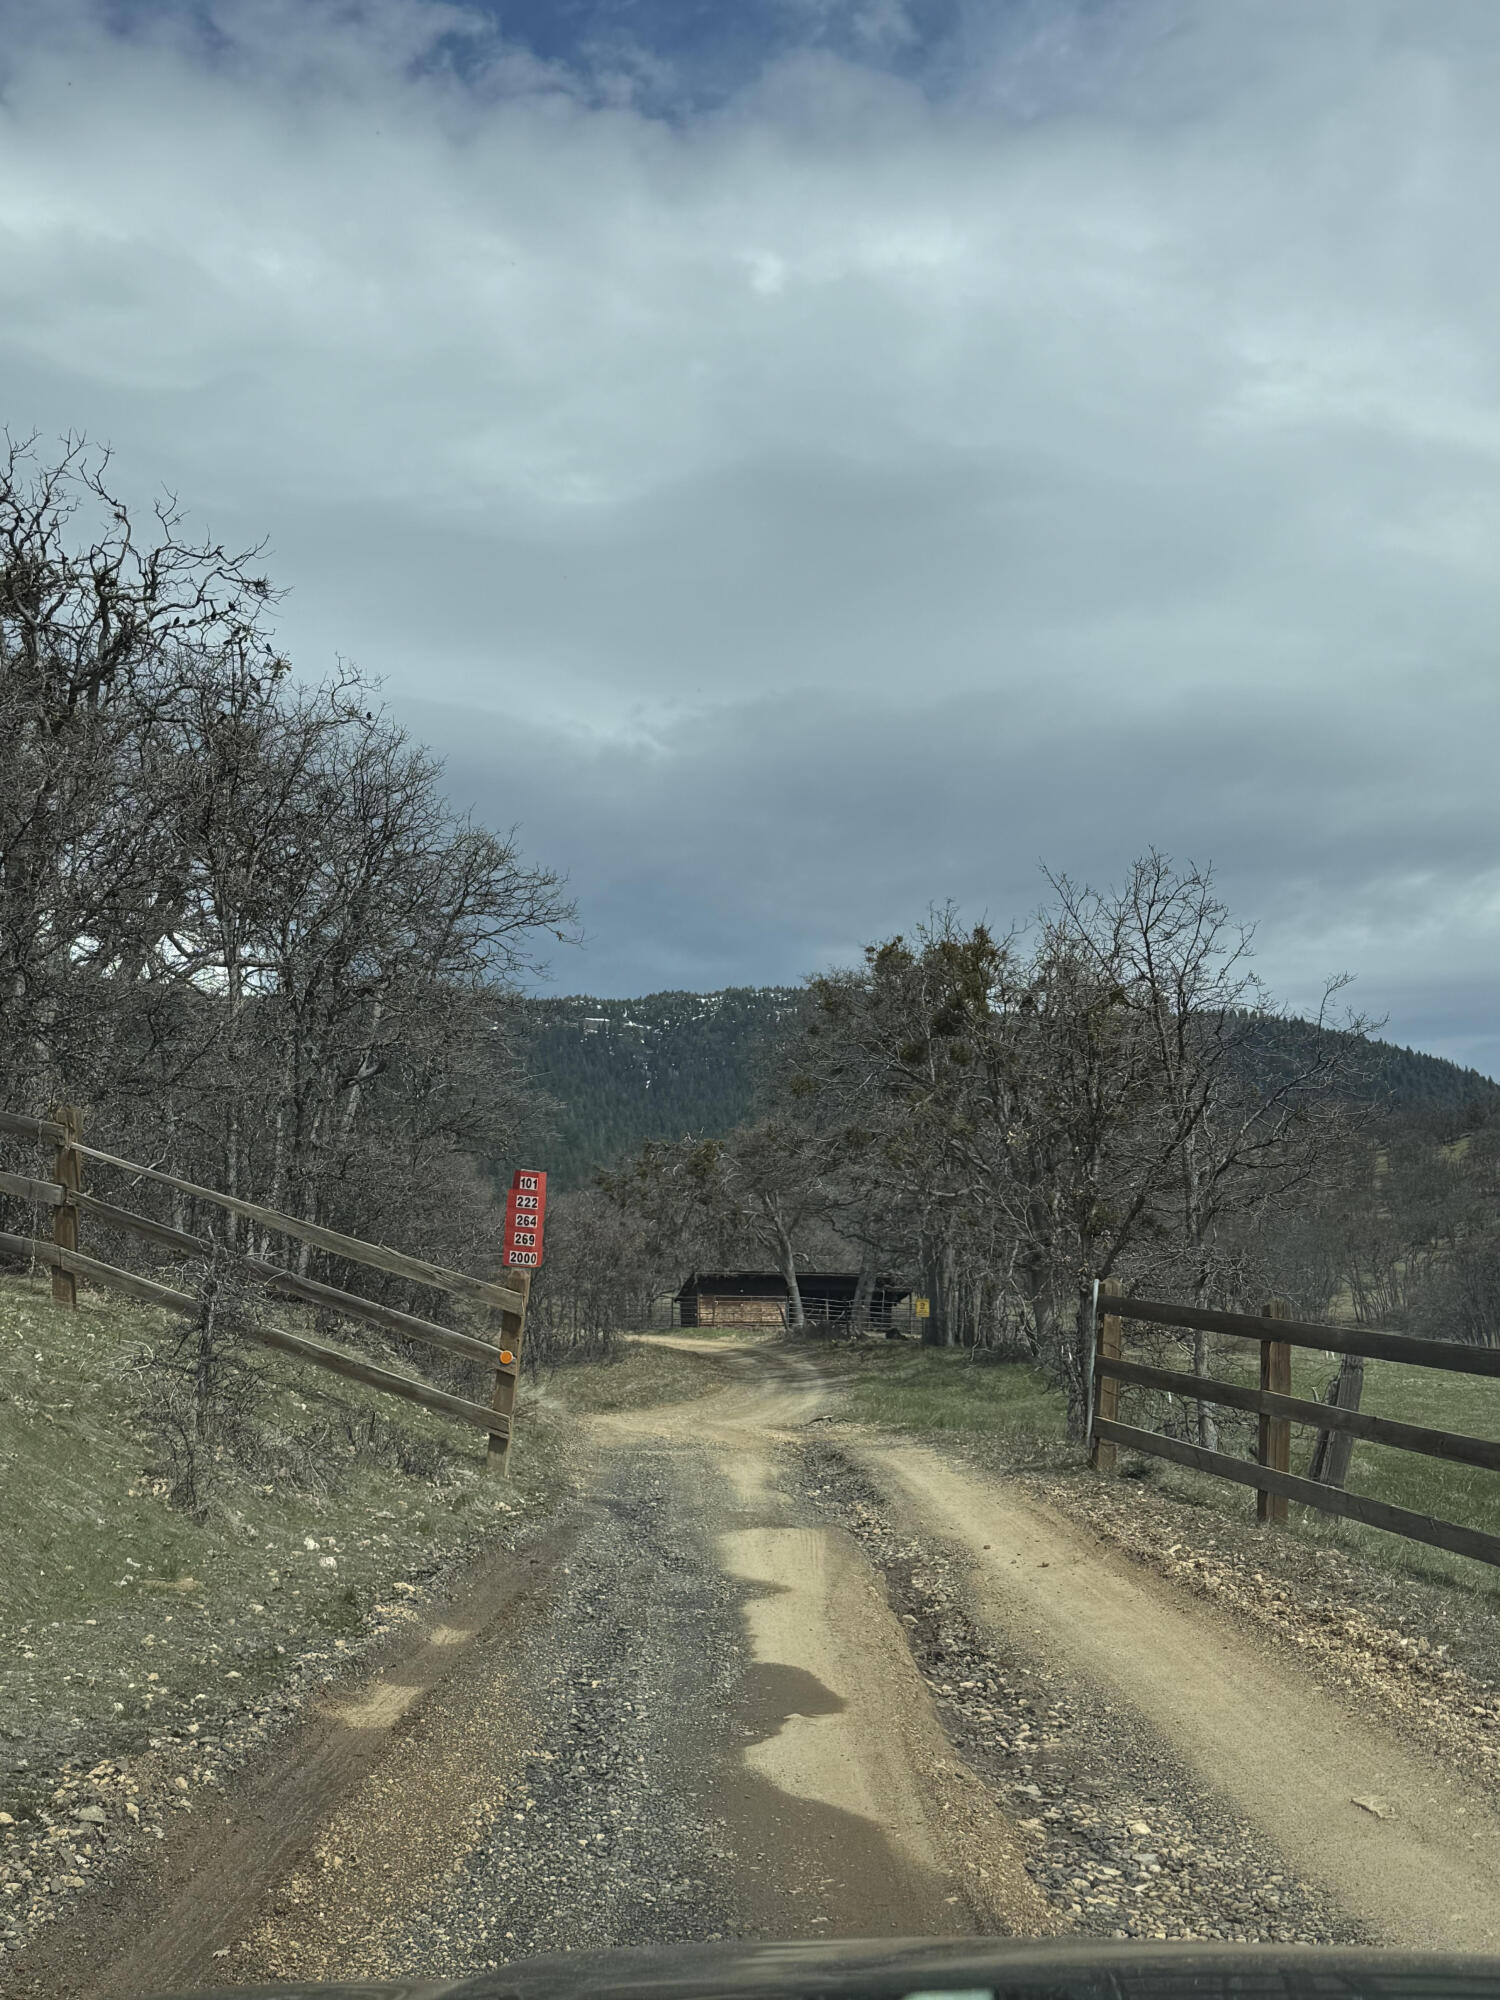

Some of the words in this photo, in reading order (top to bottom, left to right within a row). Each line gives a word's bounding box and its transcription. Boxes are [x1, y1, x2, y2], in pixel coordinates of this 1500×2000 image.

[520, 1177, 537, 1189] 101
[517, 1196, 538, 1208] 222
[516, 1215, 537, 1227] 264
[515, 1233, 535, 1245] 269
[510, 1252, 537, 1264] 2000
